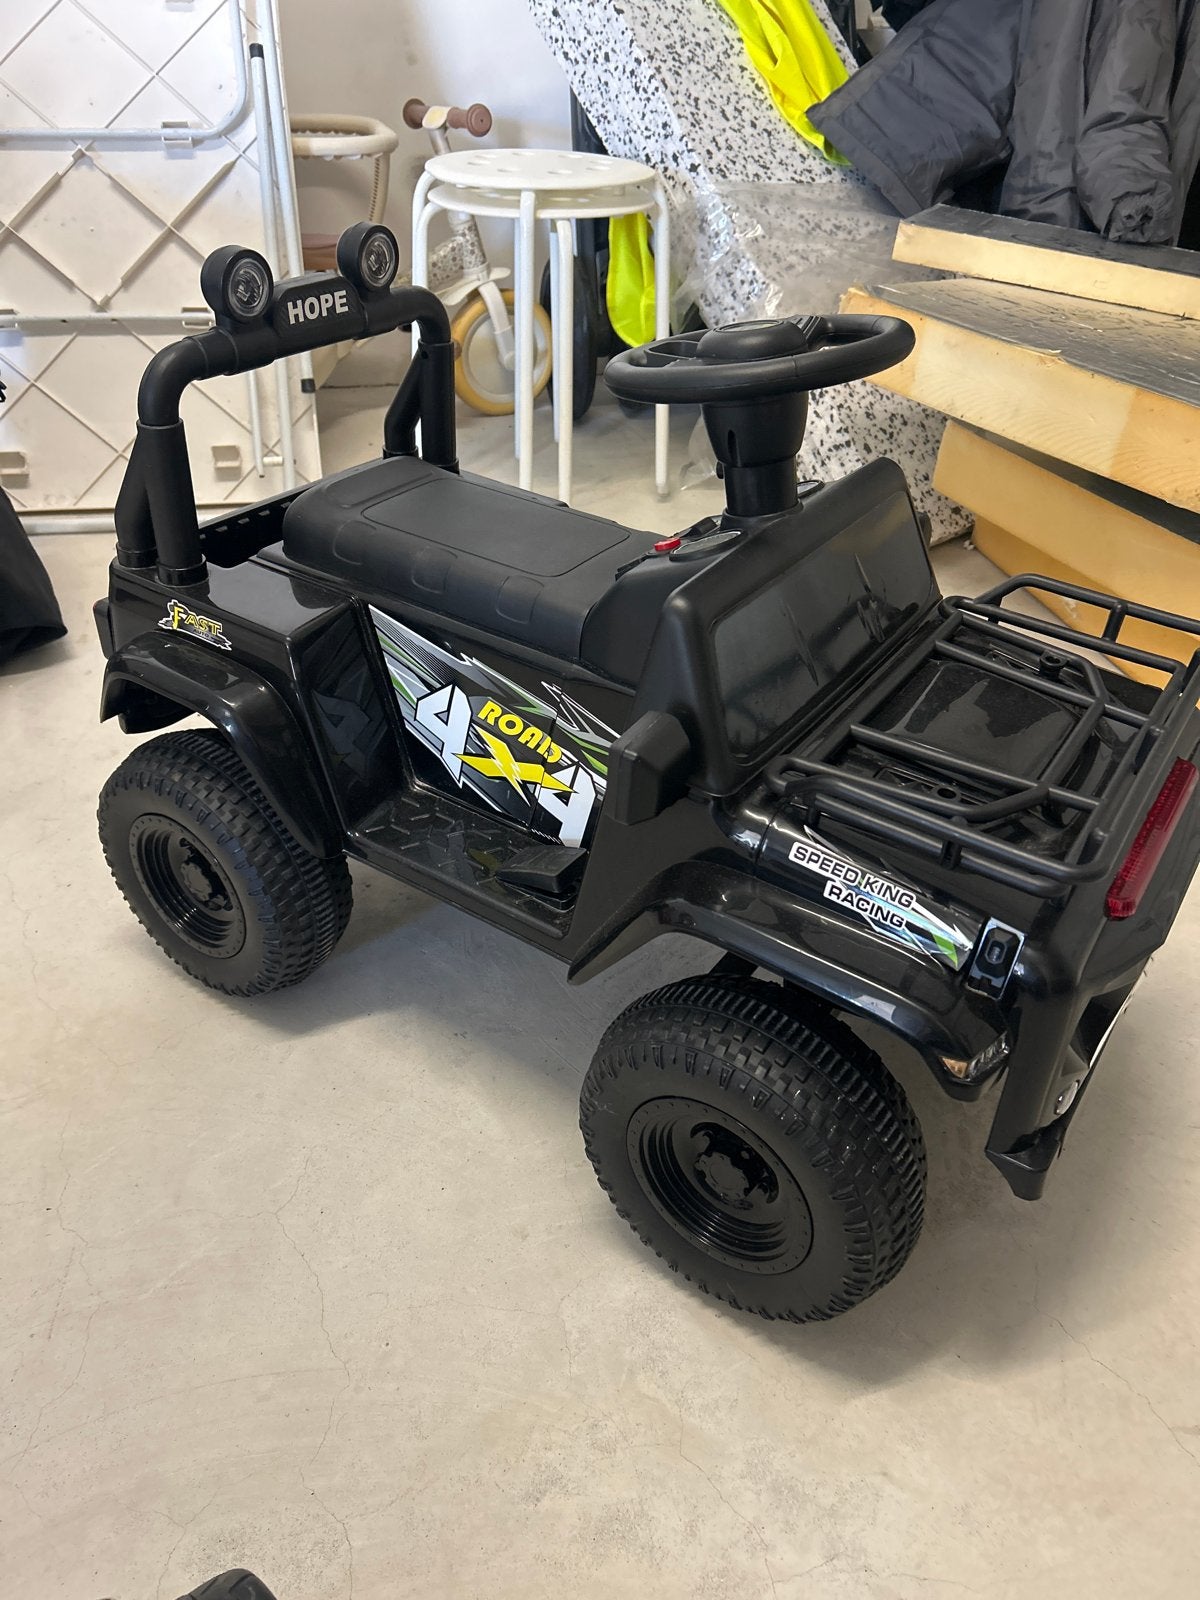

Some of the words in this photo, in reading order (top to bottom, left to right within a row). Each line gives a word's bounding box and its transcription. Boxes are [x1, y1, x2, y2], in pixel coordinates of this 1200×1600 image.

[287, 290, 349, 325] HOPE
[172, 606, 221, 635] FAST
[477, 700, 563, 764] ROAD
[793, 846, 860, 883] SPEED
[864, 876, 915, 908] KING
[828, 886, 905, 928] RACING
